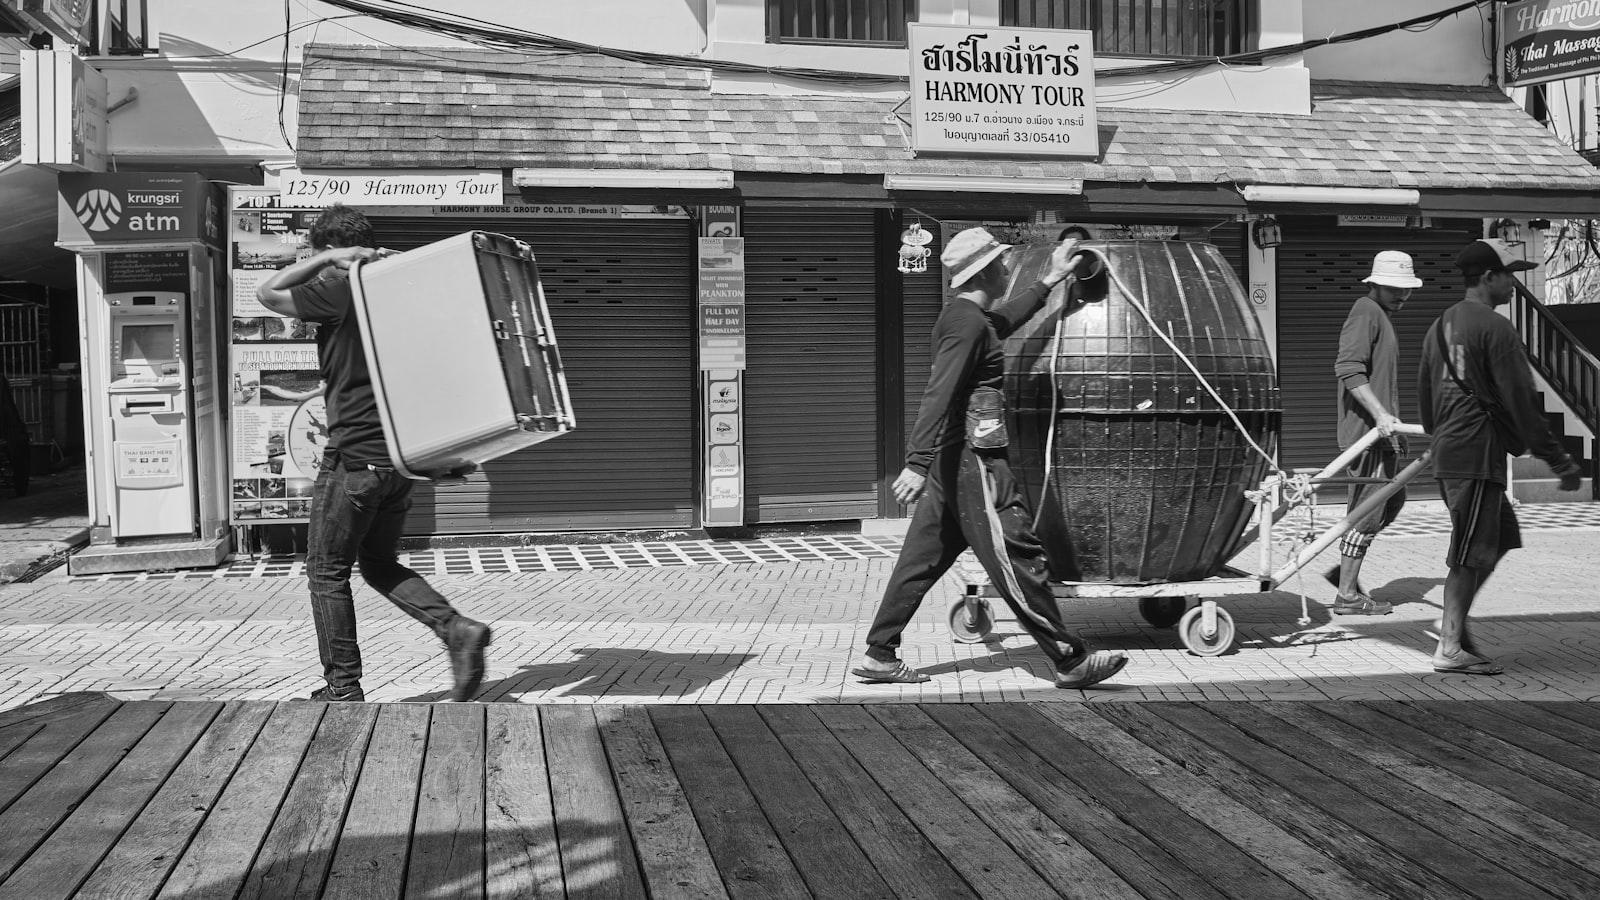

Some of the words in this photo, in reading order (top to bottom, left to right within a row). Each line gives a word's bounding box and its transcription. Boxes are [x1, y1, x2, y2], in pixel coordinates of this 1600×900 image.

[921, 33, 1080, 76] ฮาร์โมนี่ทัวร์
[1521, 42, 1548, 61] Thai
[925, 80, 1025, 105] HARMONY
[1031, 85, 1085, 107] TOUR
[925, 112, 962, 123] 125/90
[944, 128, 1010, 142] ใบอนุญาตเลขที่
[1013, 131, 1070, 144] 33/05410
[286, 179, 350, 199] 125/90
[363, 178, 448, 200] Harmony
[455, 179, 499, 195] Tour
[127, 192, 180, 206] krungsri
[248, 196, 271, 208] TOP
[128, 212, 180, 231] atm
[242, 350, 271, 362] FULL
[274, 350, 298, 362] DAY
